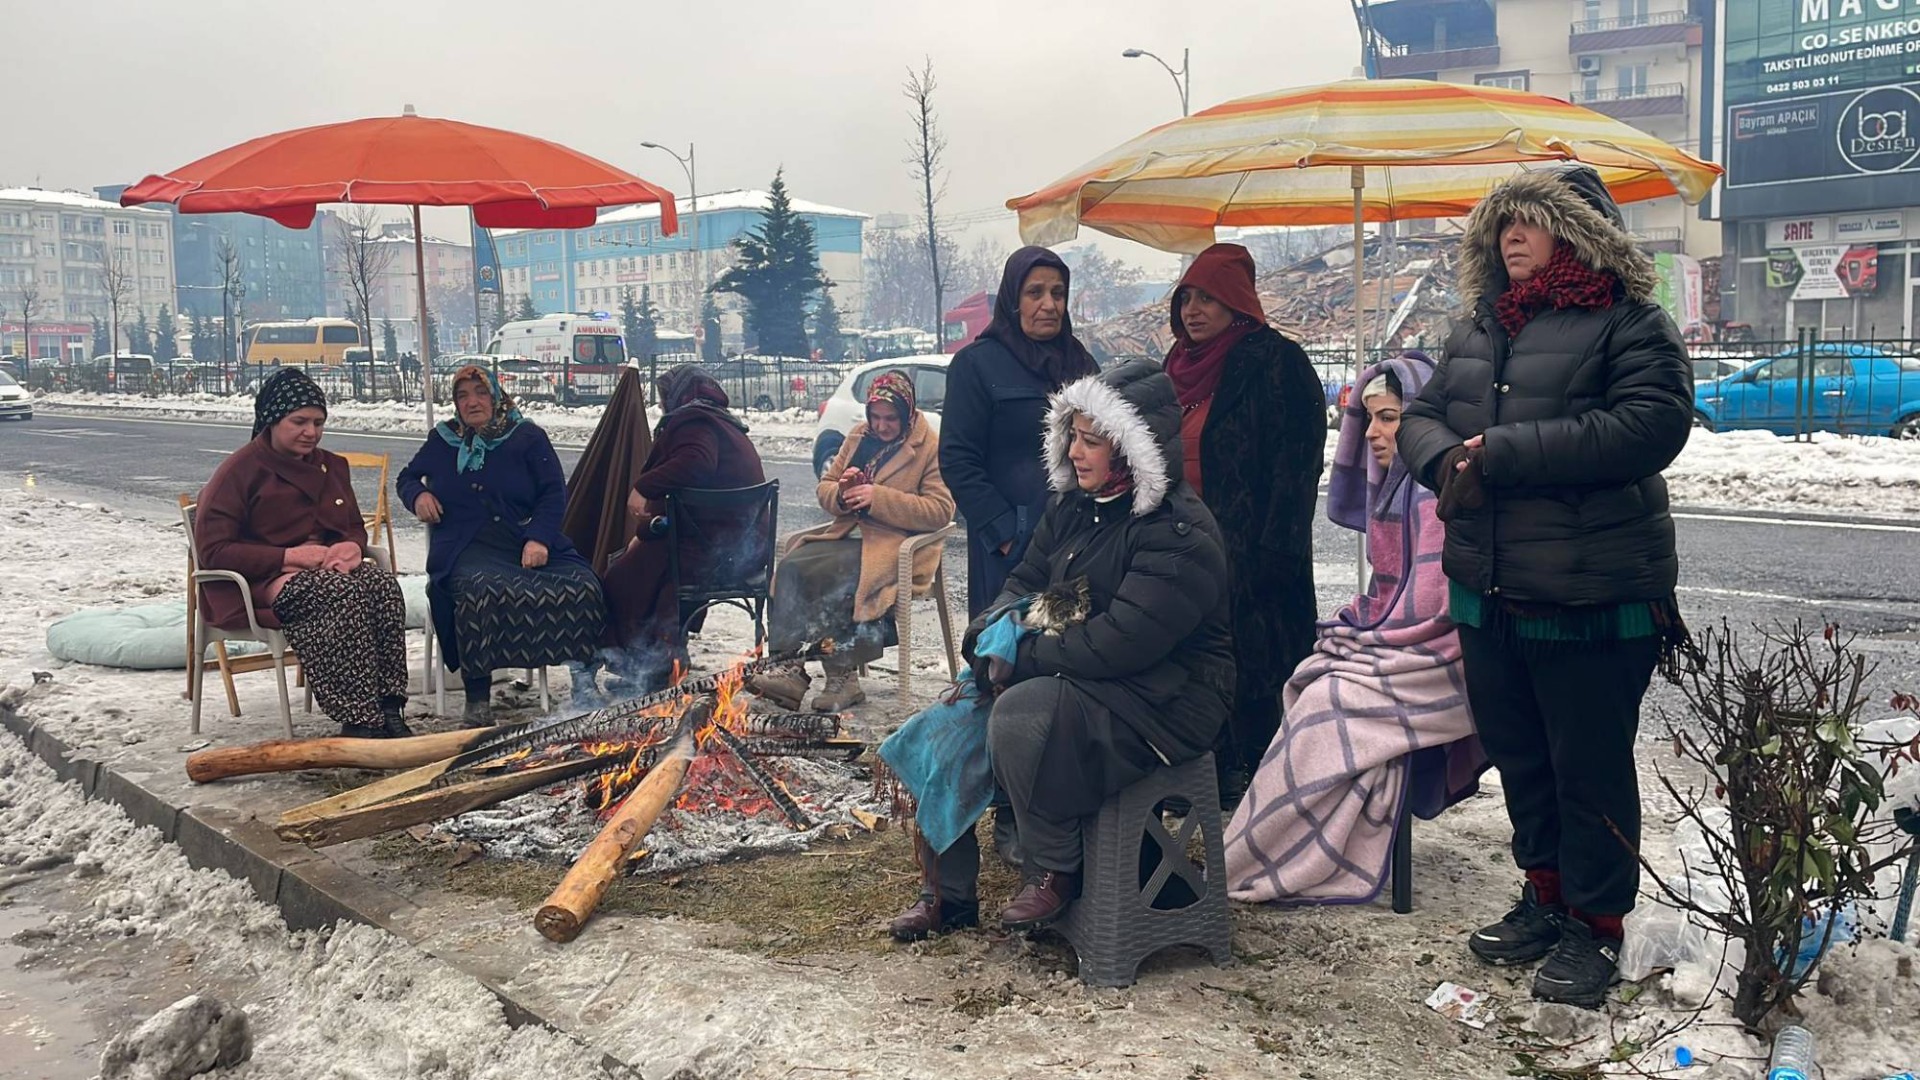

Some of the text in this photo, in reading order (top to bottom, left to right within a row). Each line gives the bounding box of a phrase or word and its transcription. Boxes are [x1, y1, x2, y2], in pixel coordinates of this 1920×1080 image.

[1813, 49, 1855, 66] KONUT
[1856, 42, 1903, 60] EDİNME
[1766, 75, 1839, 93] 0422 503 03 11
[1739, 108, 1816, 130] Bayram APAÇIK
[1851, 137, 1915, 154] Design
[1784, 221, 1814, 241] SAME
[576, 326, 617, 334] AMBULANS
